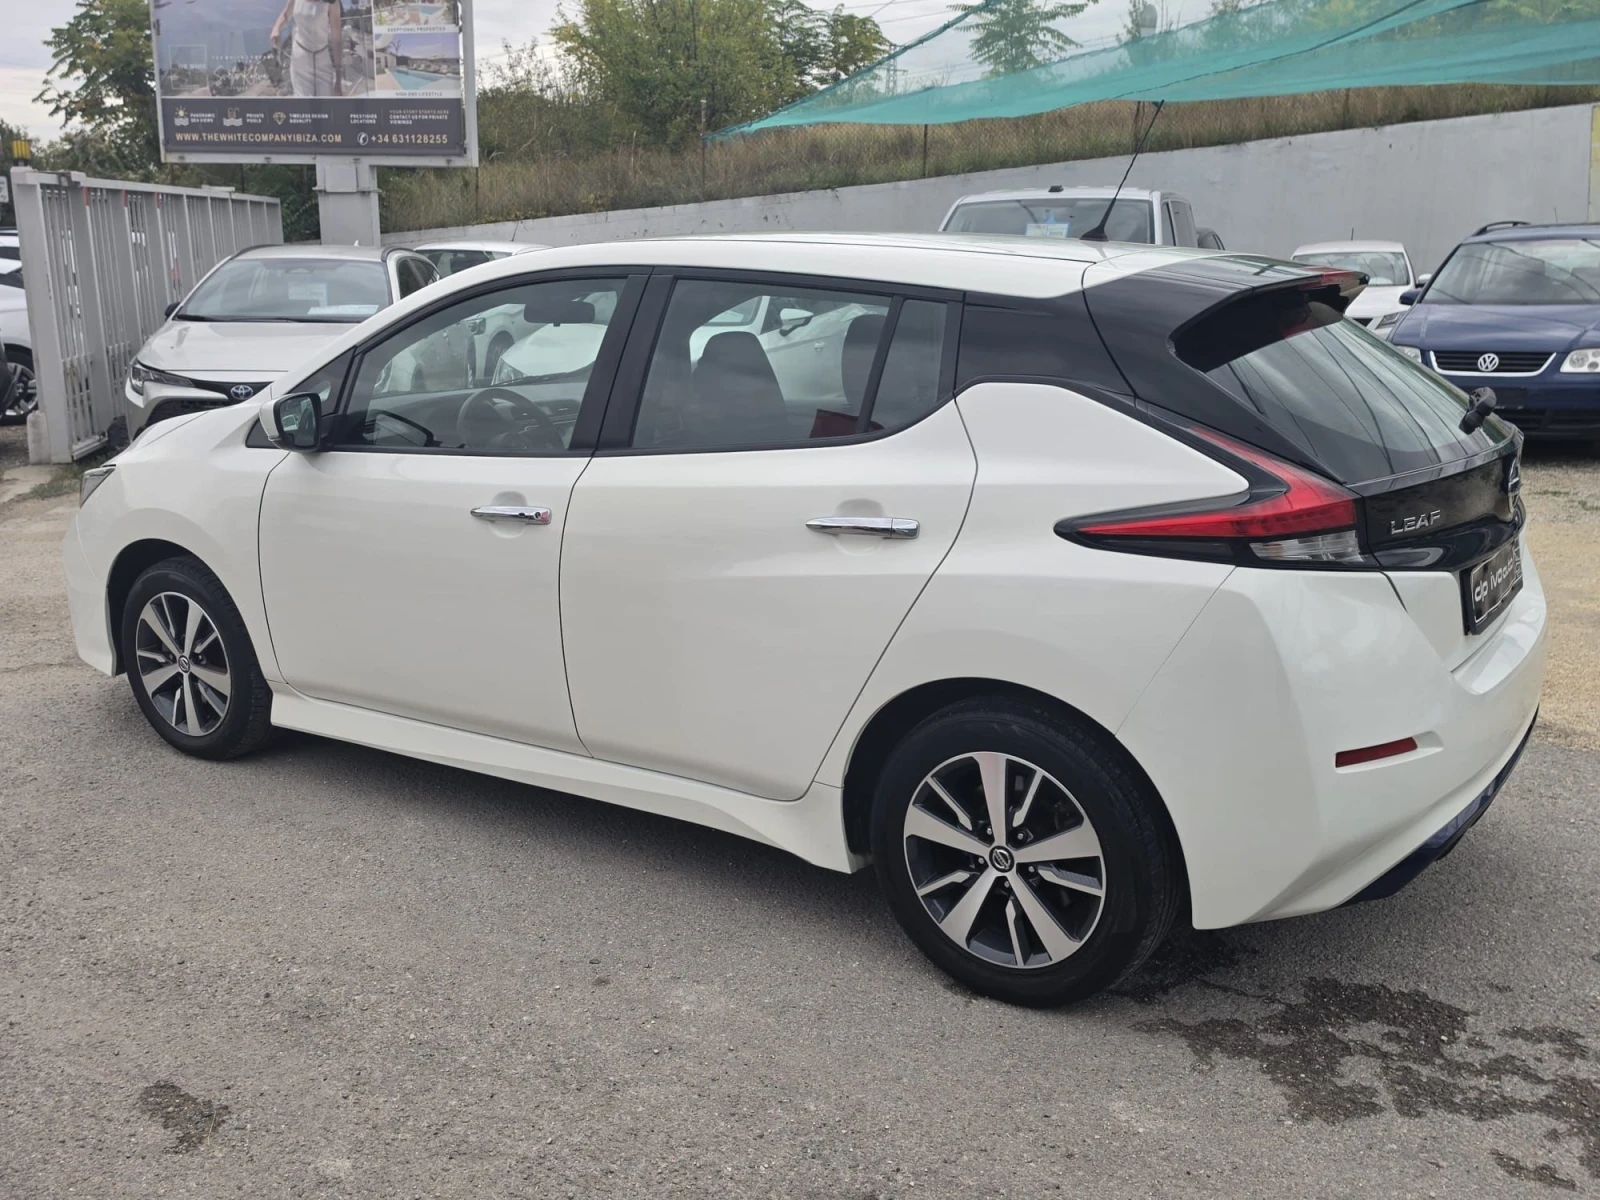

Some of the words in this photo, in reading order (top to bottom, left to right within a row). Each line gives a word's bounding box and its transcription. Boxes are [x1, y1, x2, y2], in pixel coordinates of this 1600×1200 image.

[175, 132, 342, 143] WWW.THEWHITECOMPANYIBIZA.COM
[371, 134, 389, 143] +34
[392, 133, 448, 144] 631128255
[1390, 509, 1441, 535] LEAF
